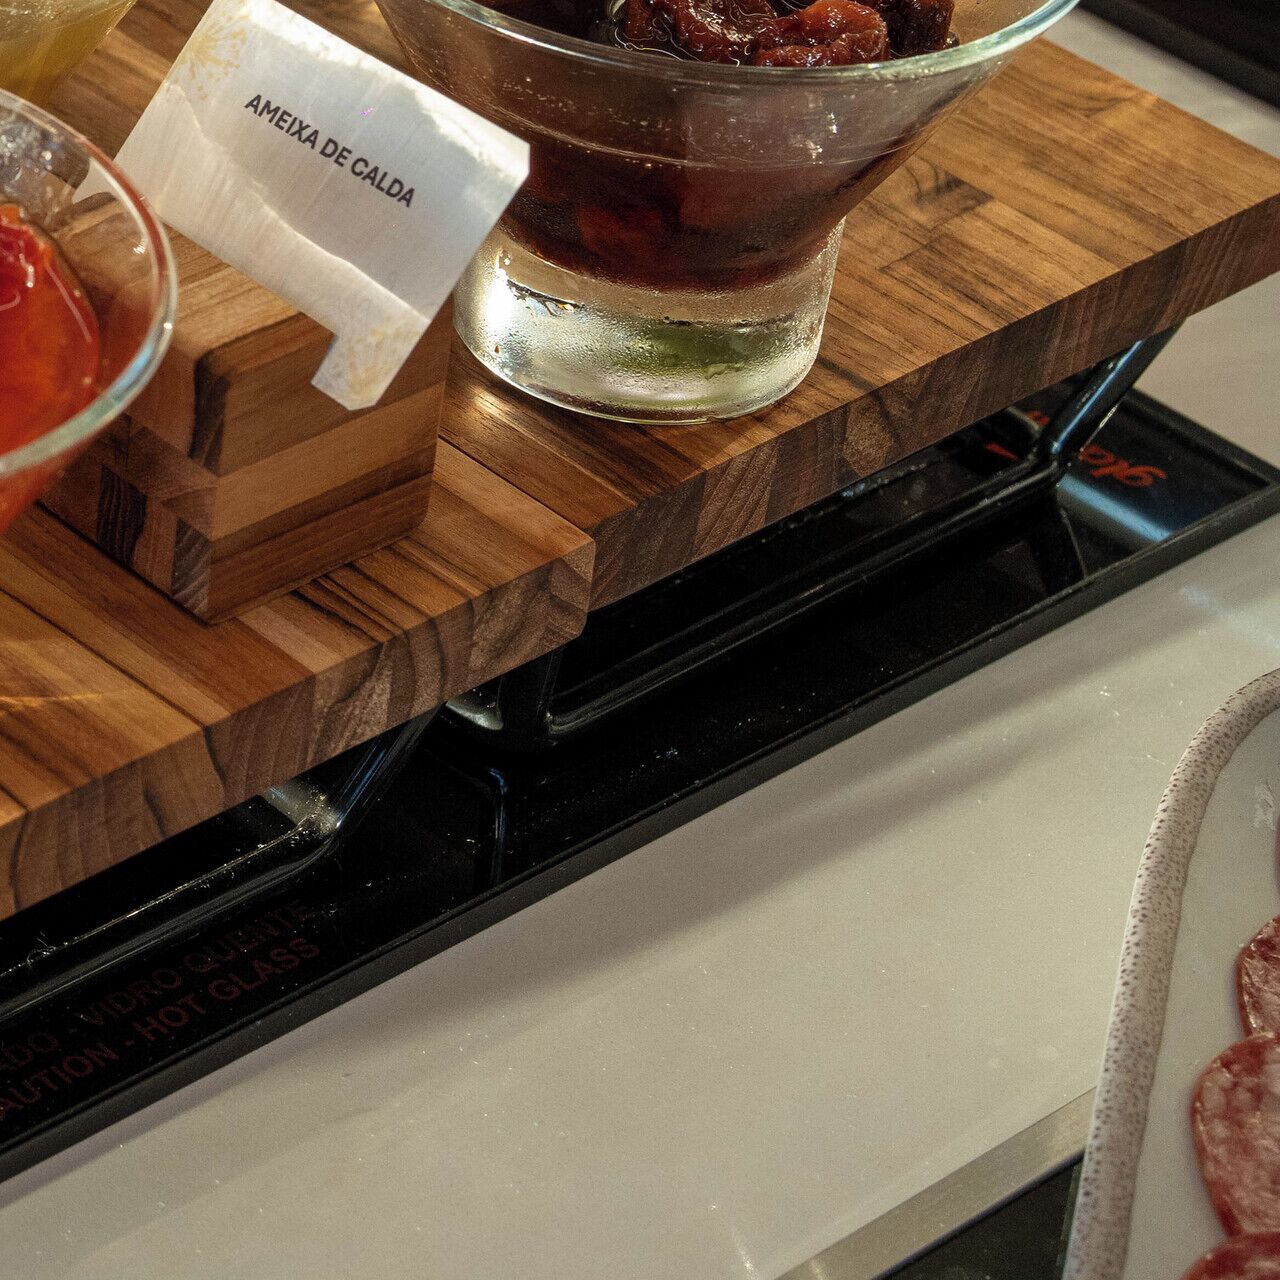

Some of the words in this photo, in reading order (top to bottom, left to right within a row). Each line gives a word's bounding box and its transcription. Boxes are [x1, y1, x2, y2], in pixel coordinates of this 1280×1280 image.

[243, 94, 320, 150] AMEIXA
[318, 137, 353, 167] DE
[350, 157, 416, 209] CALDA
[80, 967, 185, 1027] VIDRO
[182, 897, 319, 975] QUENTE
[134, 993, 209, 1043] HOT
[207, 935, 322, 1004] GLASS
